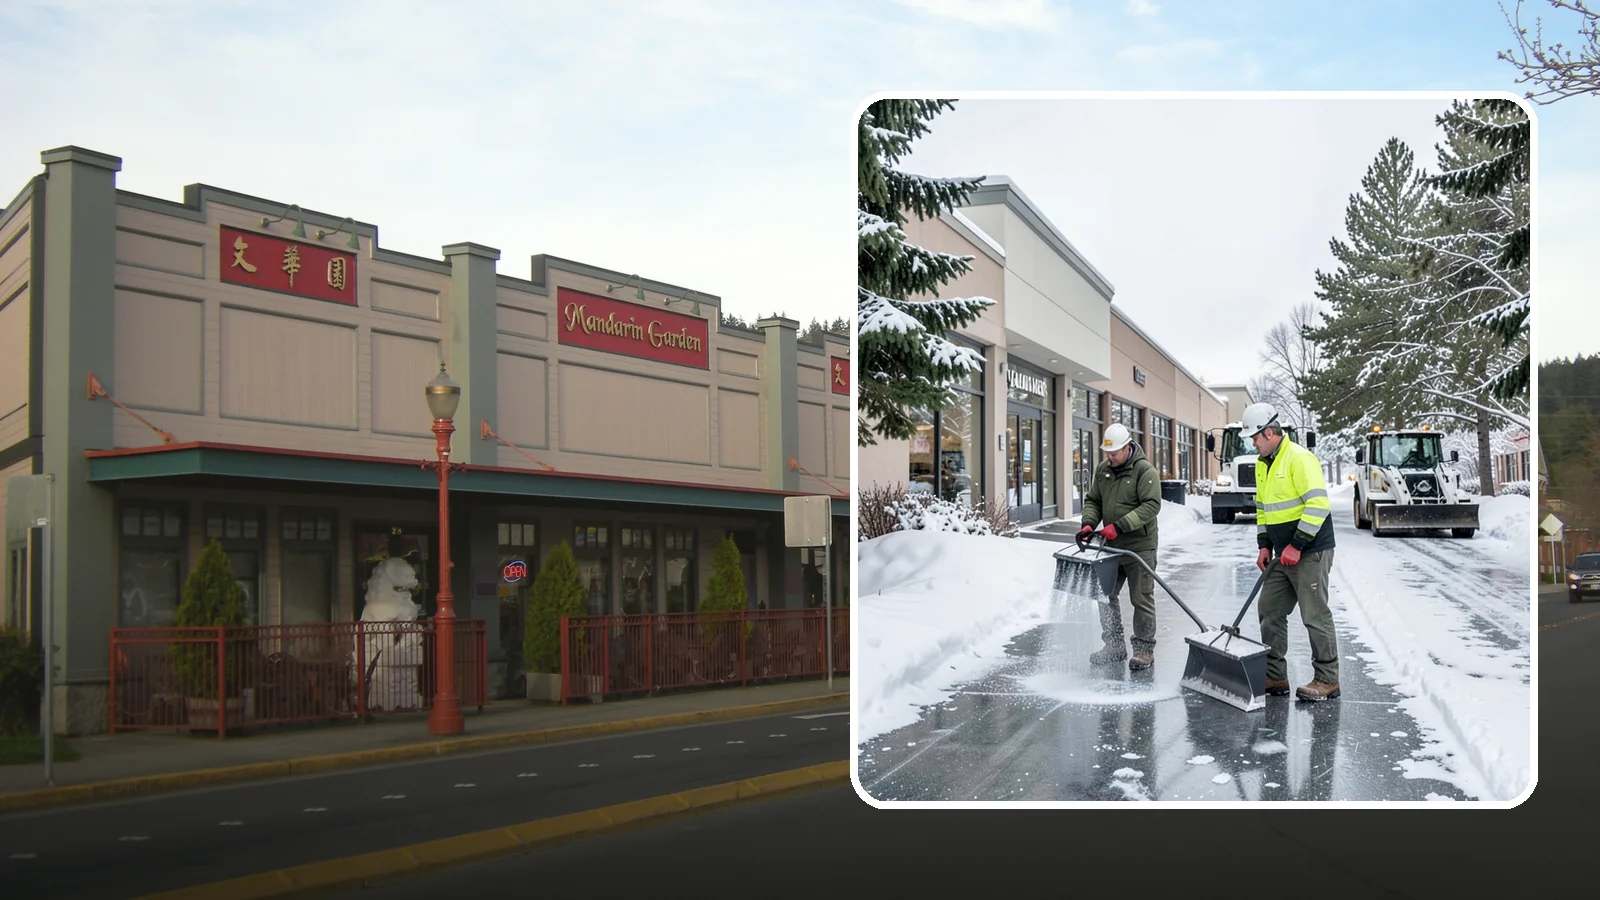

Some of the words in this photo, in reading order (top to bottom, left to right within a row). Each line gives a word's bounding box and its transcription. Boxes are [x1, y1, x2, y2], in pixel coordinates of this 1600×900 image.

[564, 302, 644, 341] Mandarin
[647, 319, 701, 352] Garden
[503, 565, 527, 578] OPEN
